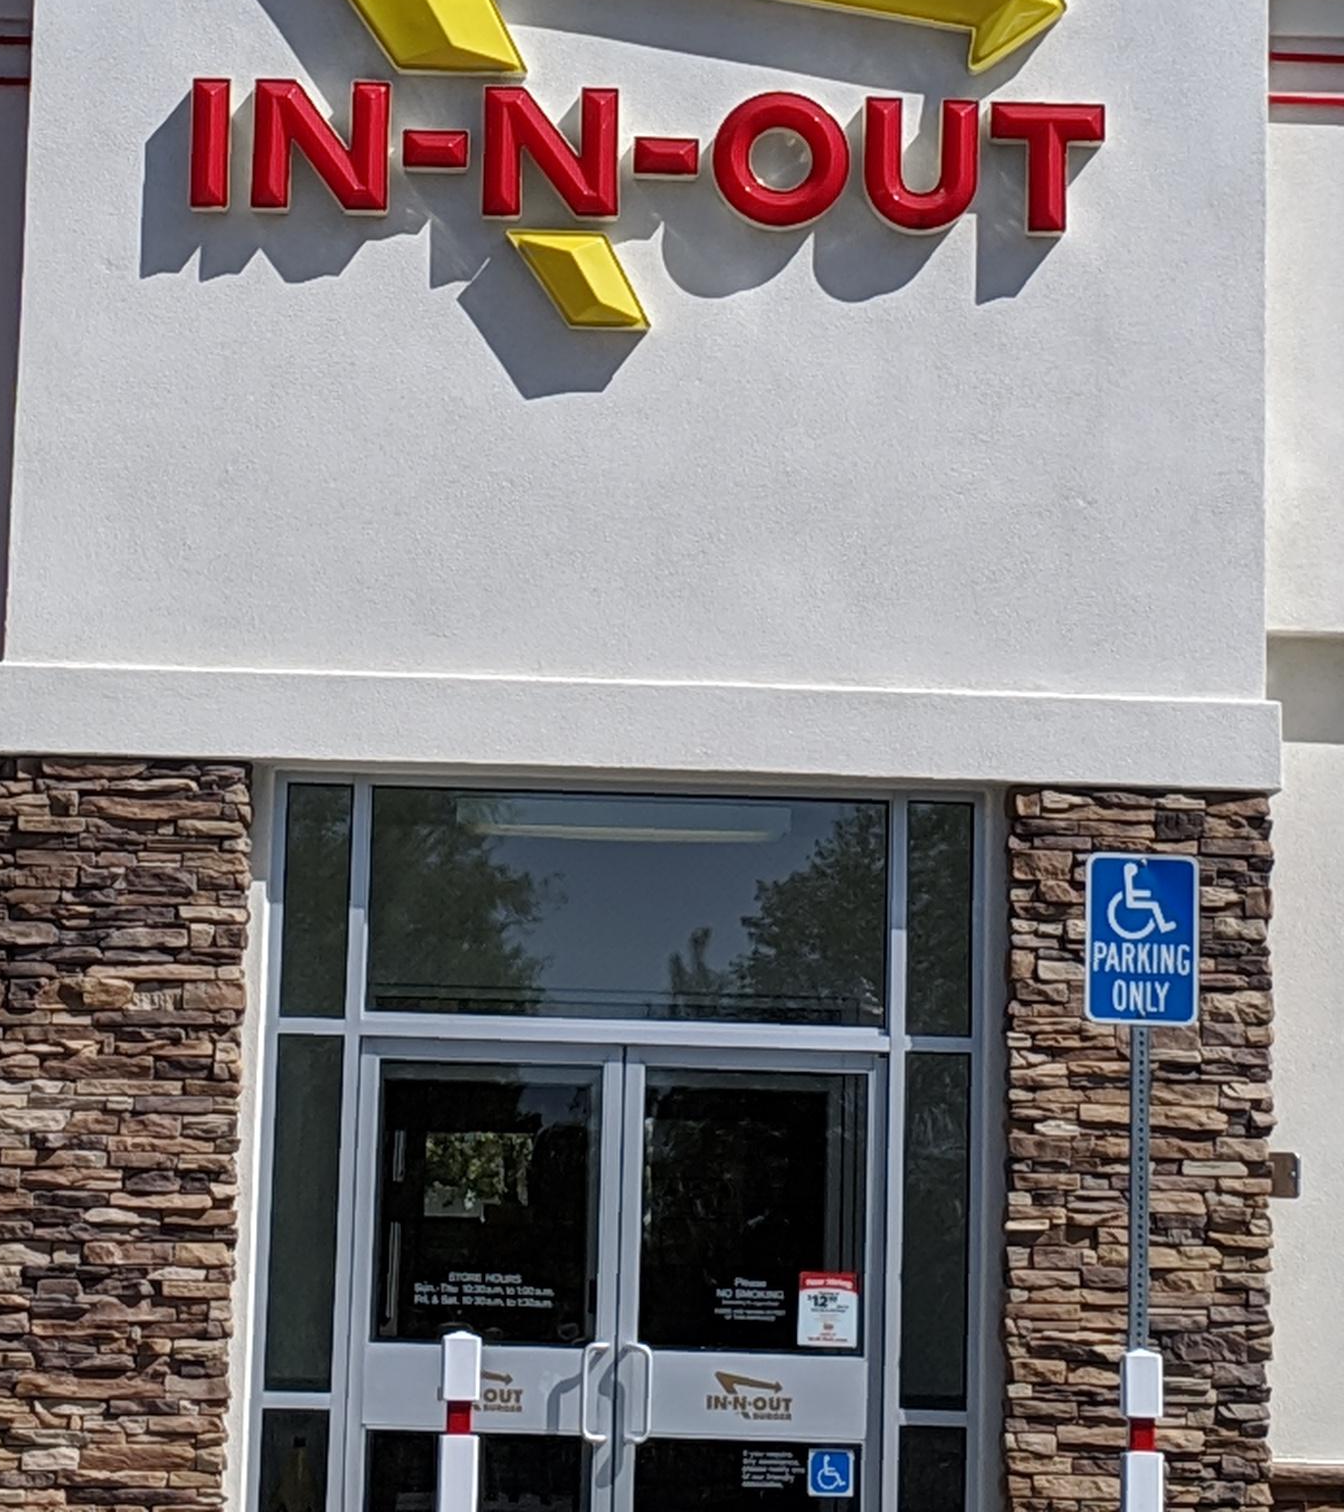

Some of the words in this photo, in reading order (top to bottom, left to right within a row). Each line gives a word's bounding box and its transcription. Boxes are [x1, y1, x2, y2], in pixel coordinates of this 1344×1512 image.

[189, 77, 1107, 236] IN-N-OUT
[1092, 940, 1191, 977] PARKING
[1111, 978, 1171, 1014] ONLY
[448, 1271, 482, 1282] STORE
[485, 1273, 522, 1284] HOURS
[716, 1288, 733, 1299] NO
